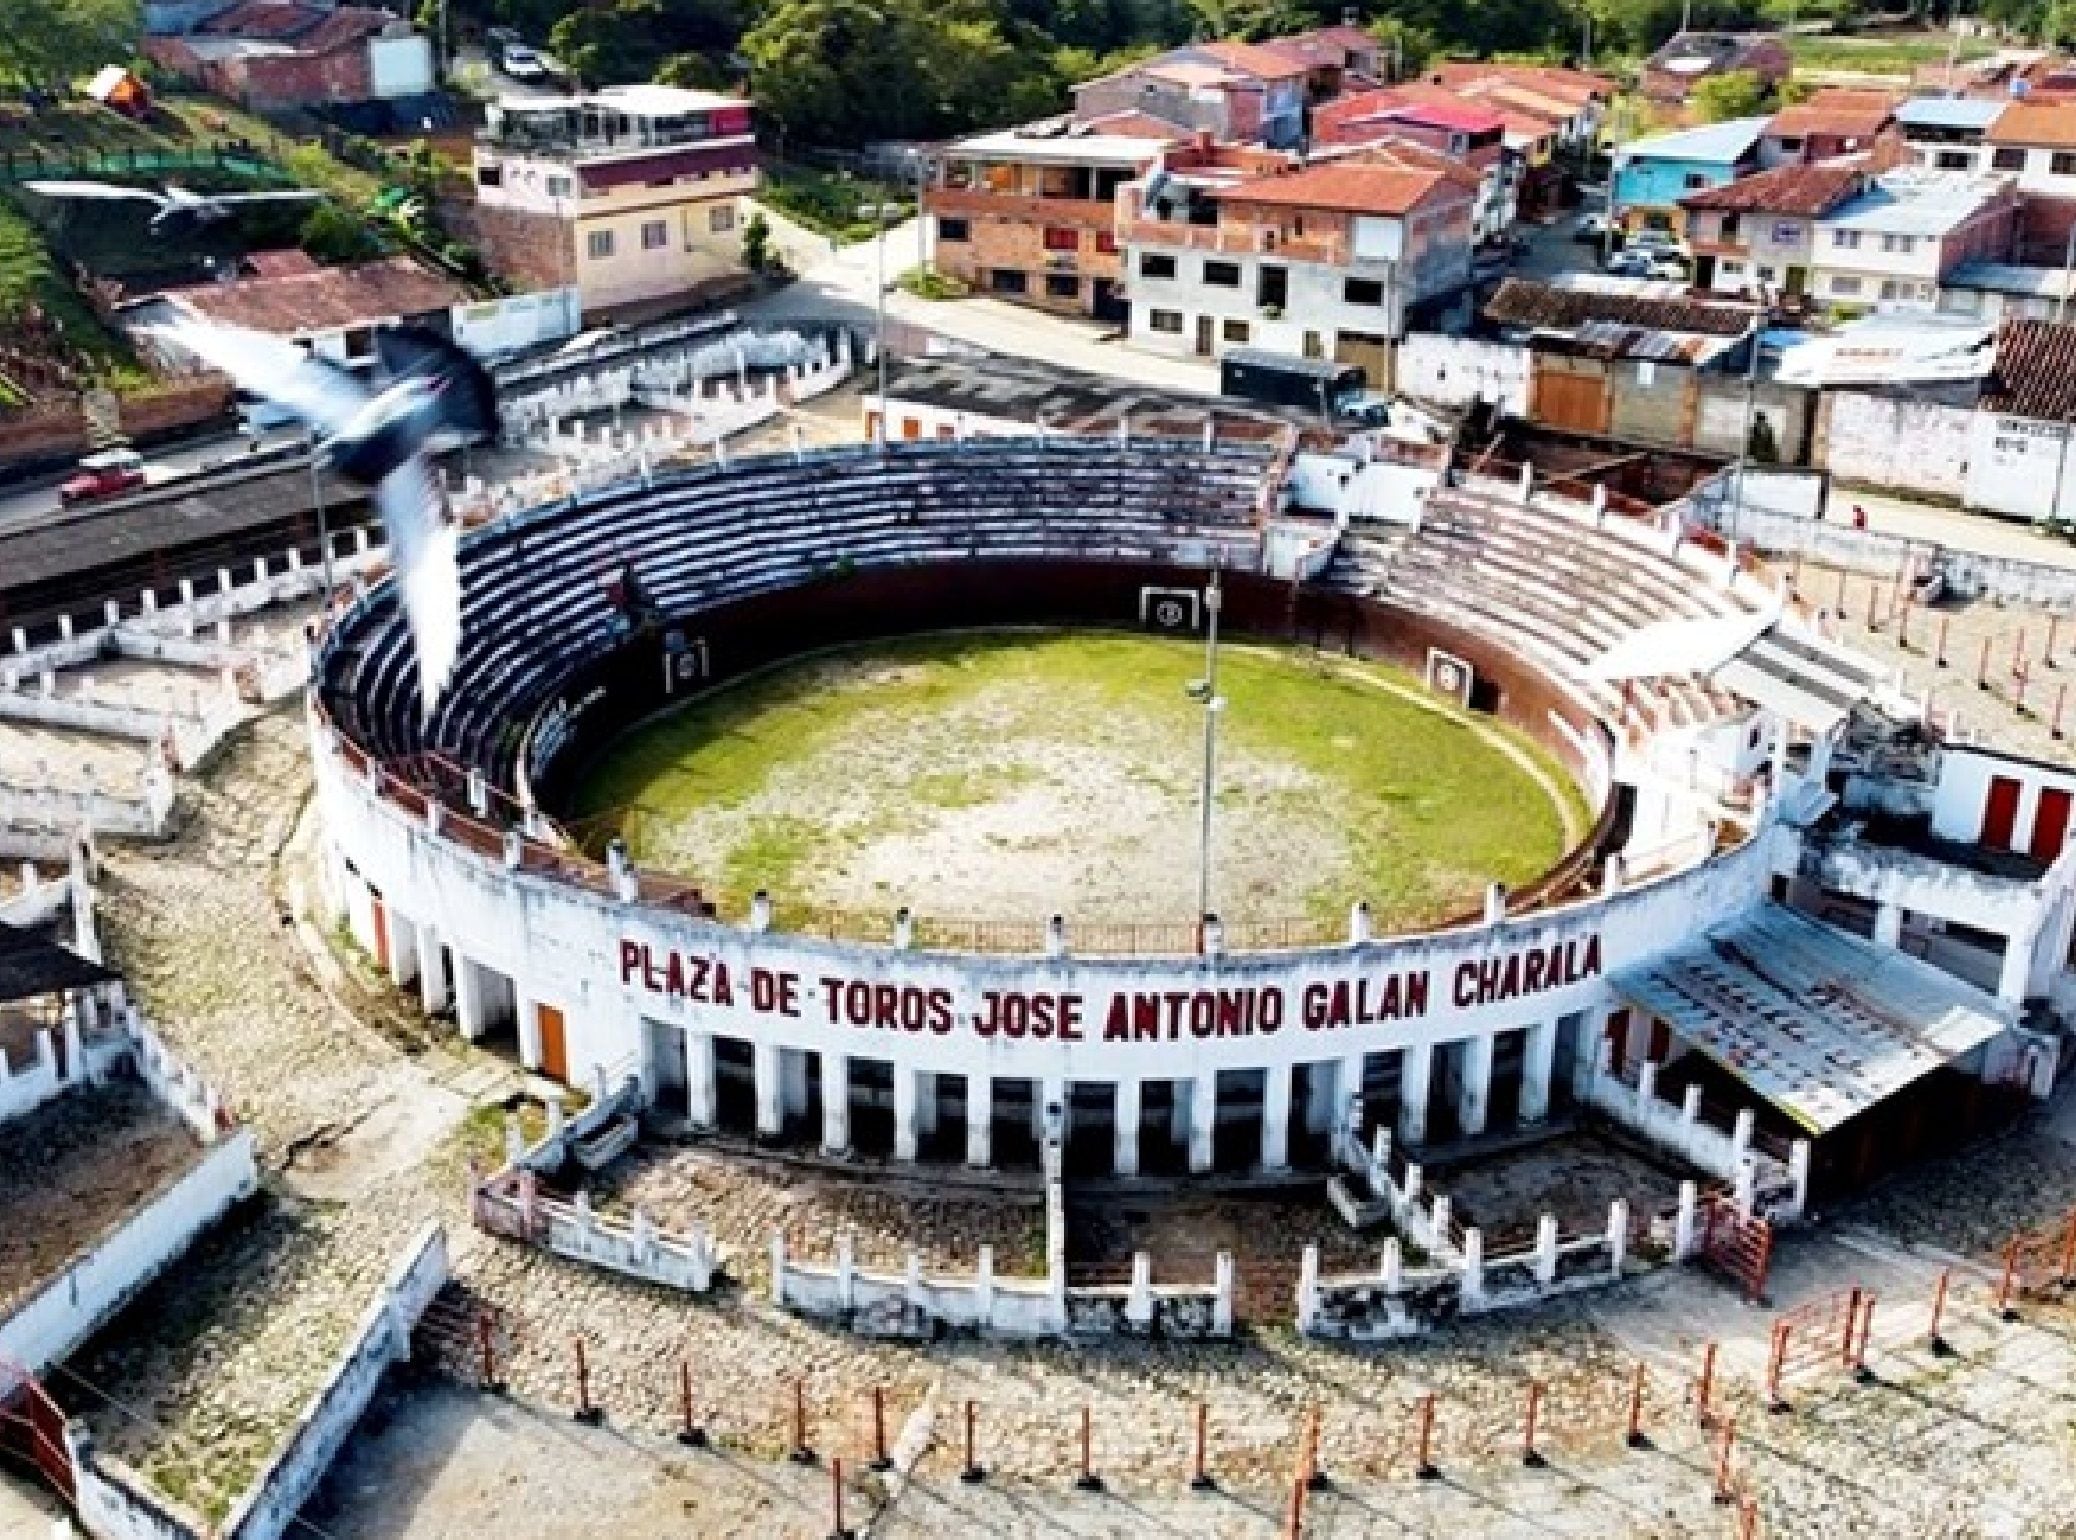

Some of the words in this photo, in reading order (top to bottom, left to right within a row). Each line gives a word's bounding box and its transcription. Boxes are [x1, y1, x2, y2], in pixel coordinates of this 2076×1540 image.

[620, 939, 735, 1006] PLAZA
[750, 968, 802, 1018] DE
[819, 977, 953, 1035] TOROS
[972, 992, 1084, 1041] JOSE
[1103, 986, 1284, 1041] ANTONIO
[1302, 970, 1430, 1031] GALAN
[1453, 934, 1602, 1007] CHARALA
